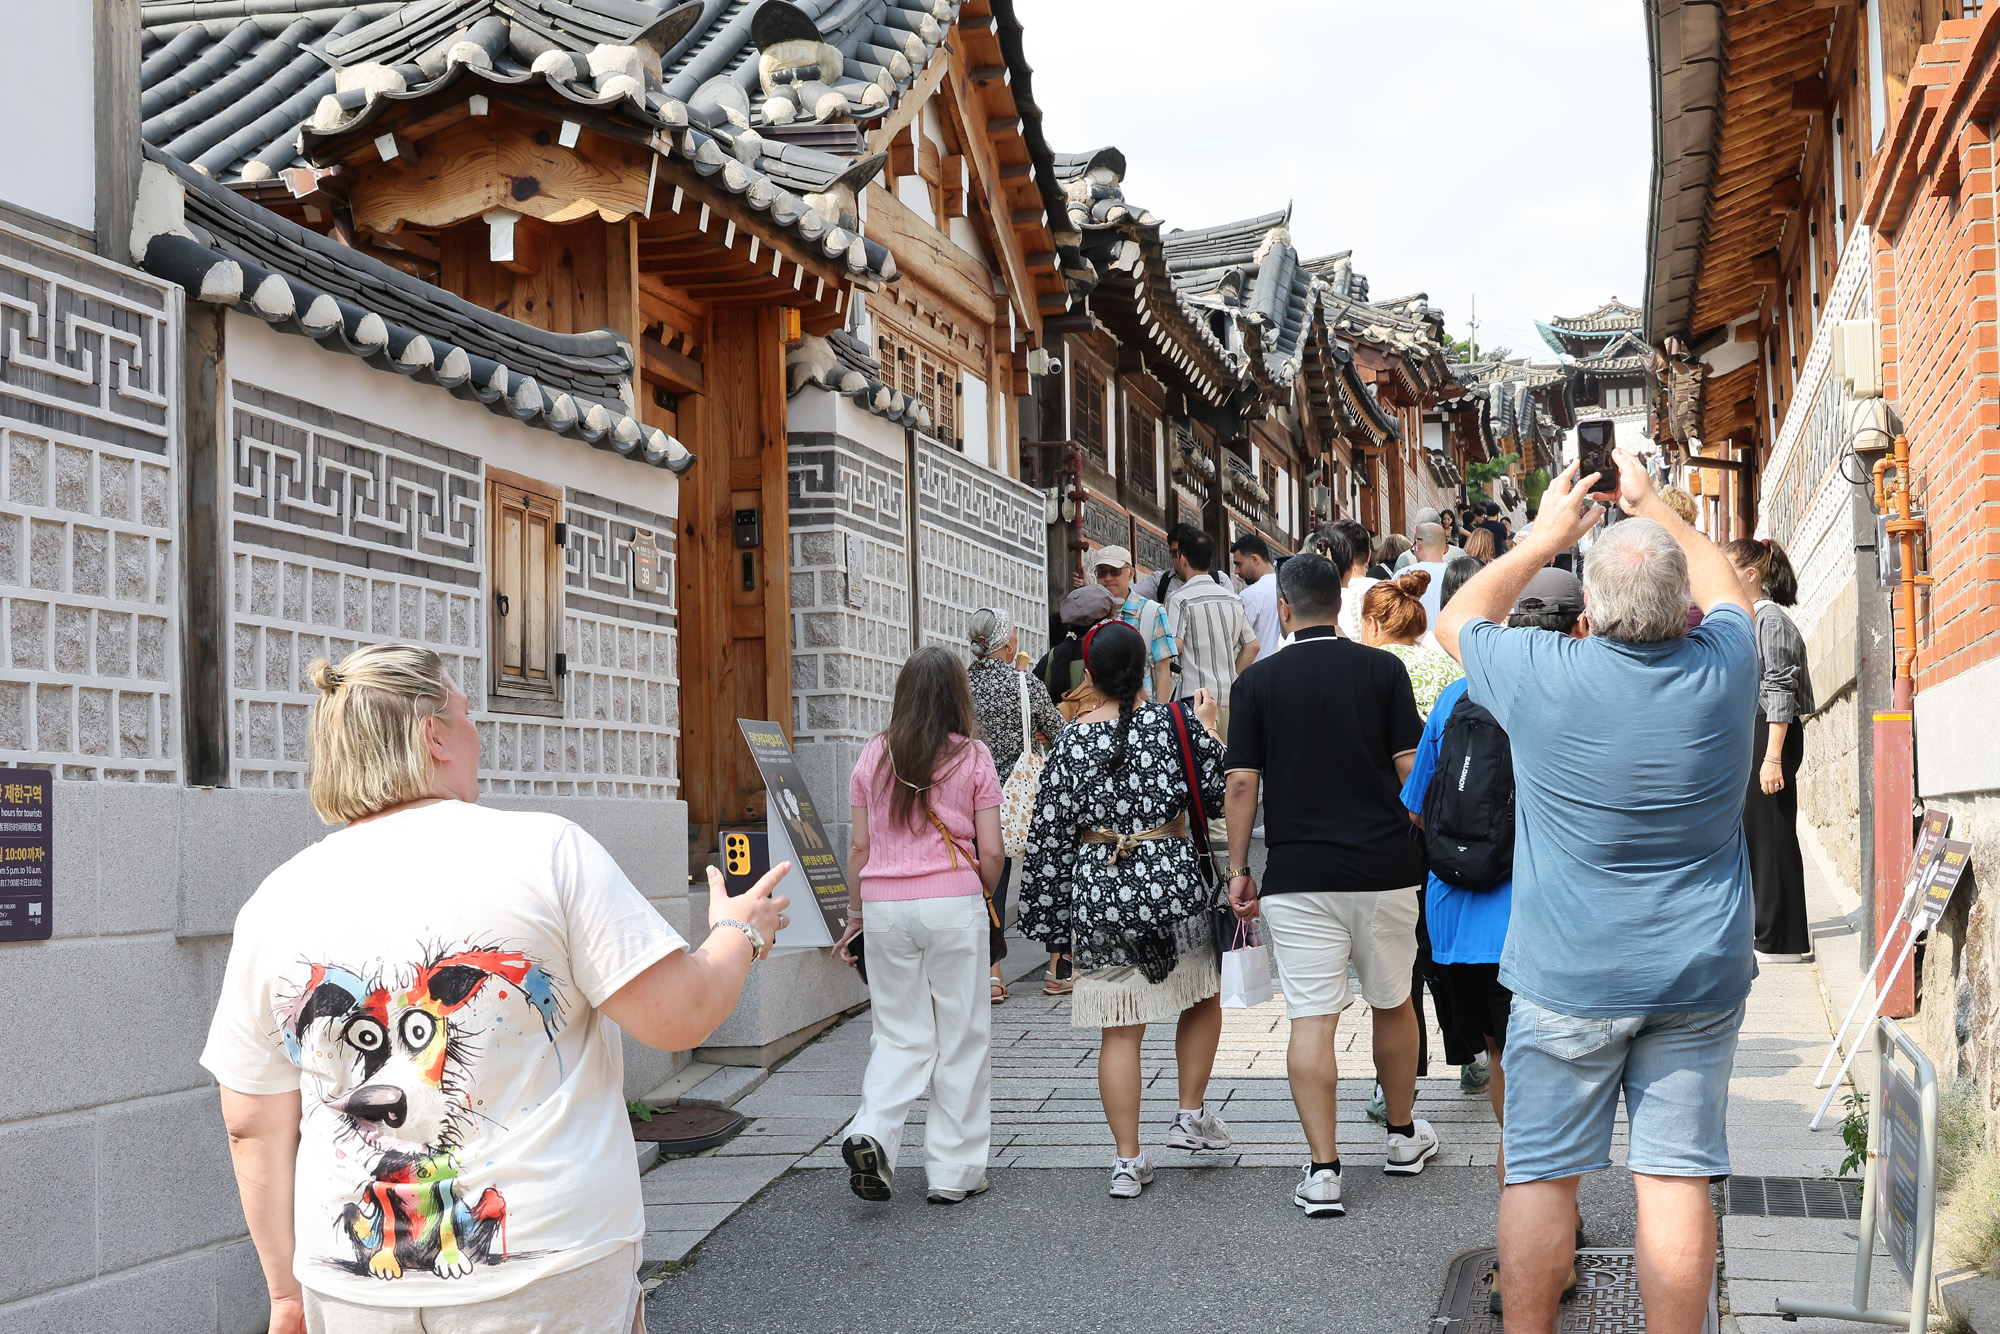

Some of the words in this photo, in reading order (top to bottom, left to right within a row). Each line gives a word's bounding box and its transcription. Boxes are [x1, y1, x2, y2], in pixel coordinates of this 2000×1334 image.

[642, 567, 650, 585] 39
[1458, 755, 1471, 792] SALOMON
[4, 783, 42, 804] 제한구역
[1, 807, 15, 817] hours
[24, 808, 42, 818] tourists
[5, 846, 42, 863] 10:00까지
